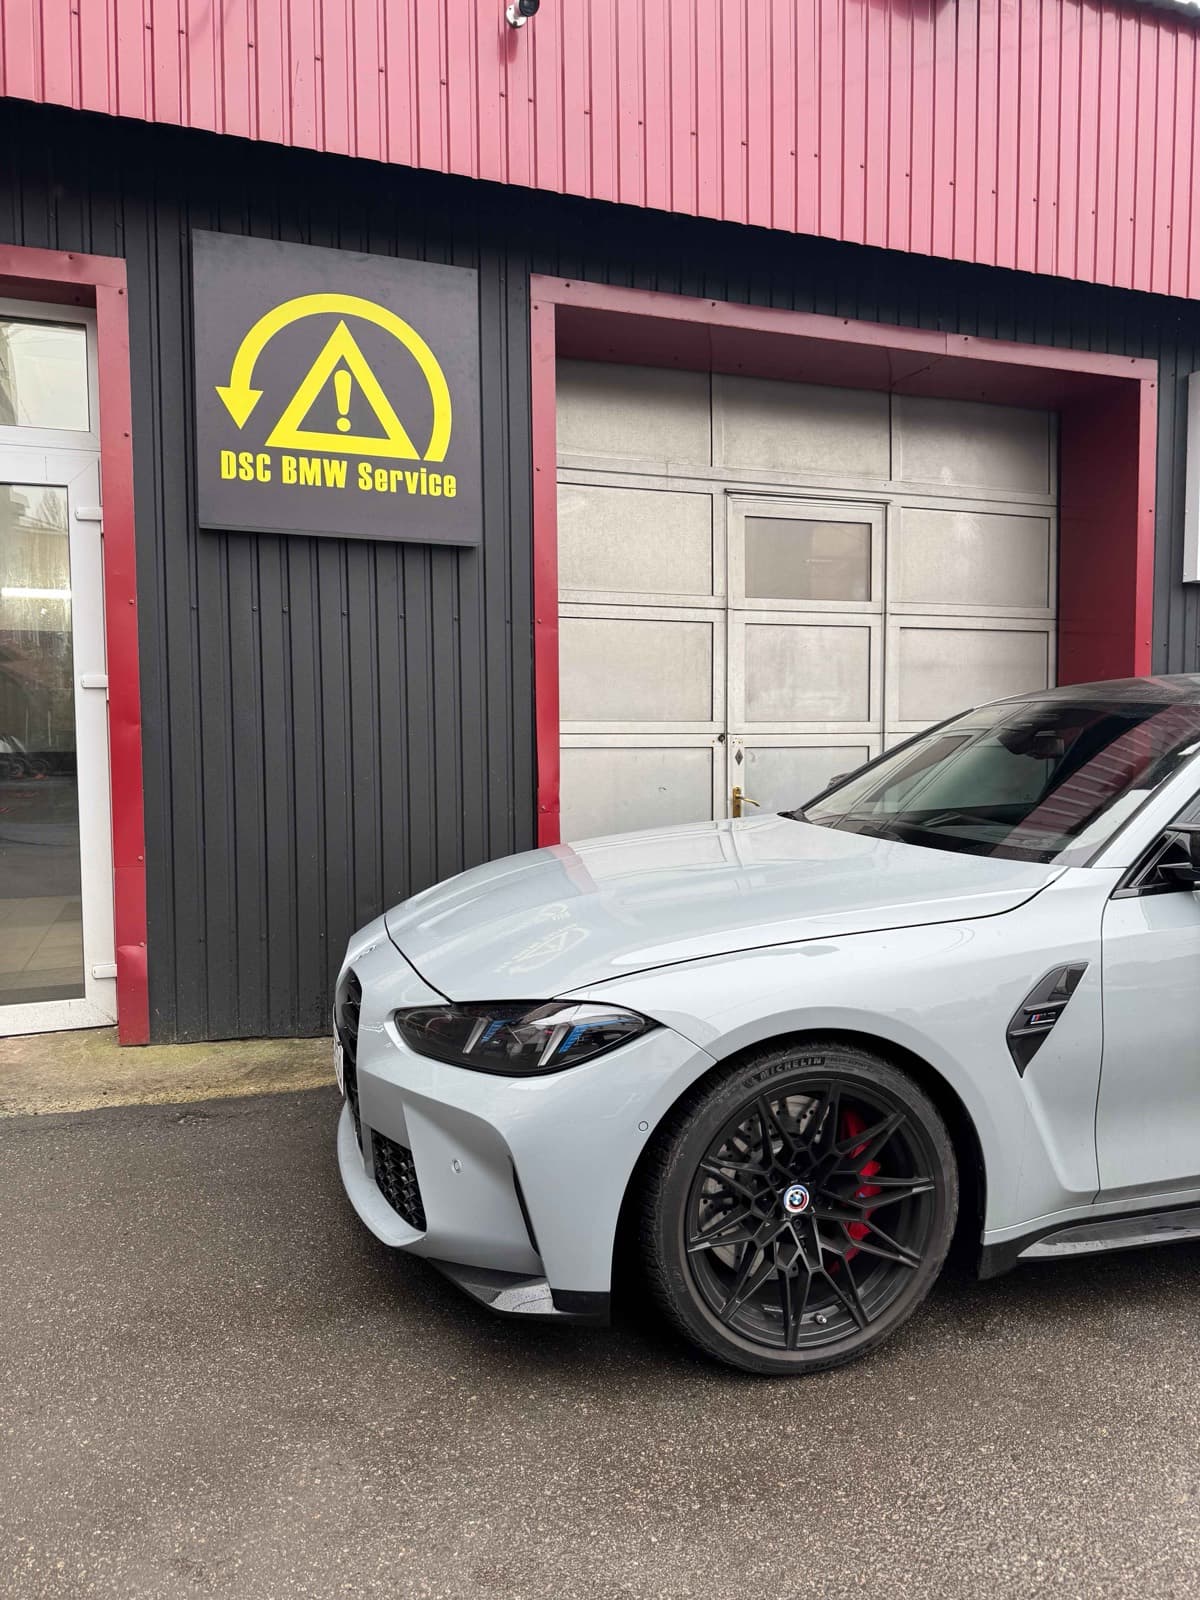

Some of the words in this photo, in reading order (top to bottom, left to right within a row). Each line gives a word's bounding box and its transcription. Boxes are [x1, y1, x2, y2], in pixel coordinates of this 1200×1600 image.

[221, 450, 272, 483] DSC
[282, 455, 348, 489] BMW
[357, 462, 457, 498] Service
[760, 1056, 823, 1081] MICHELIN
